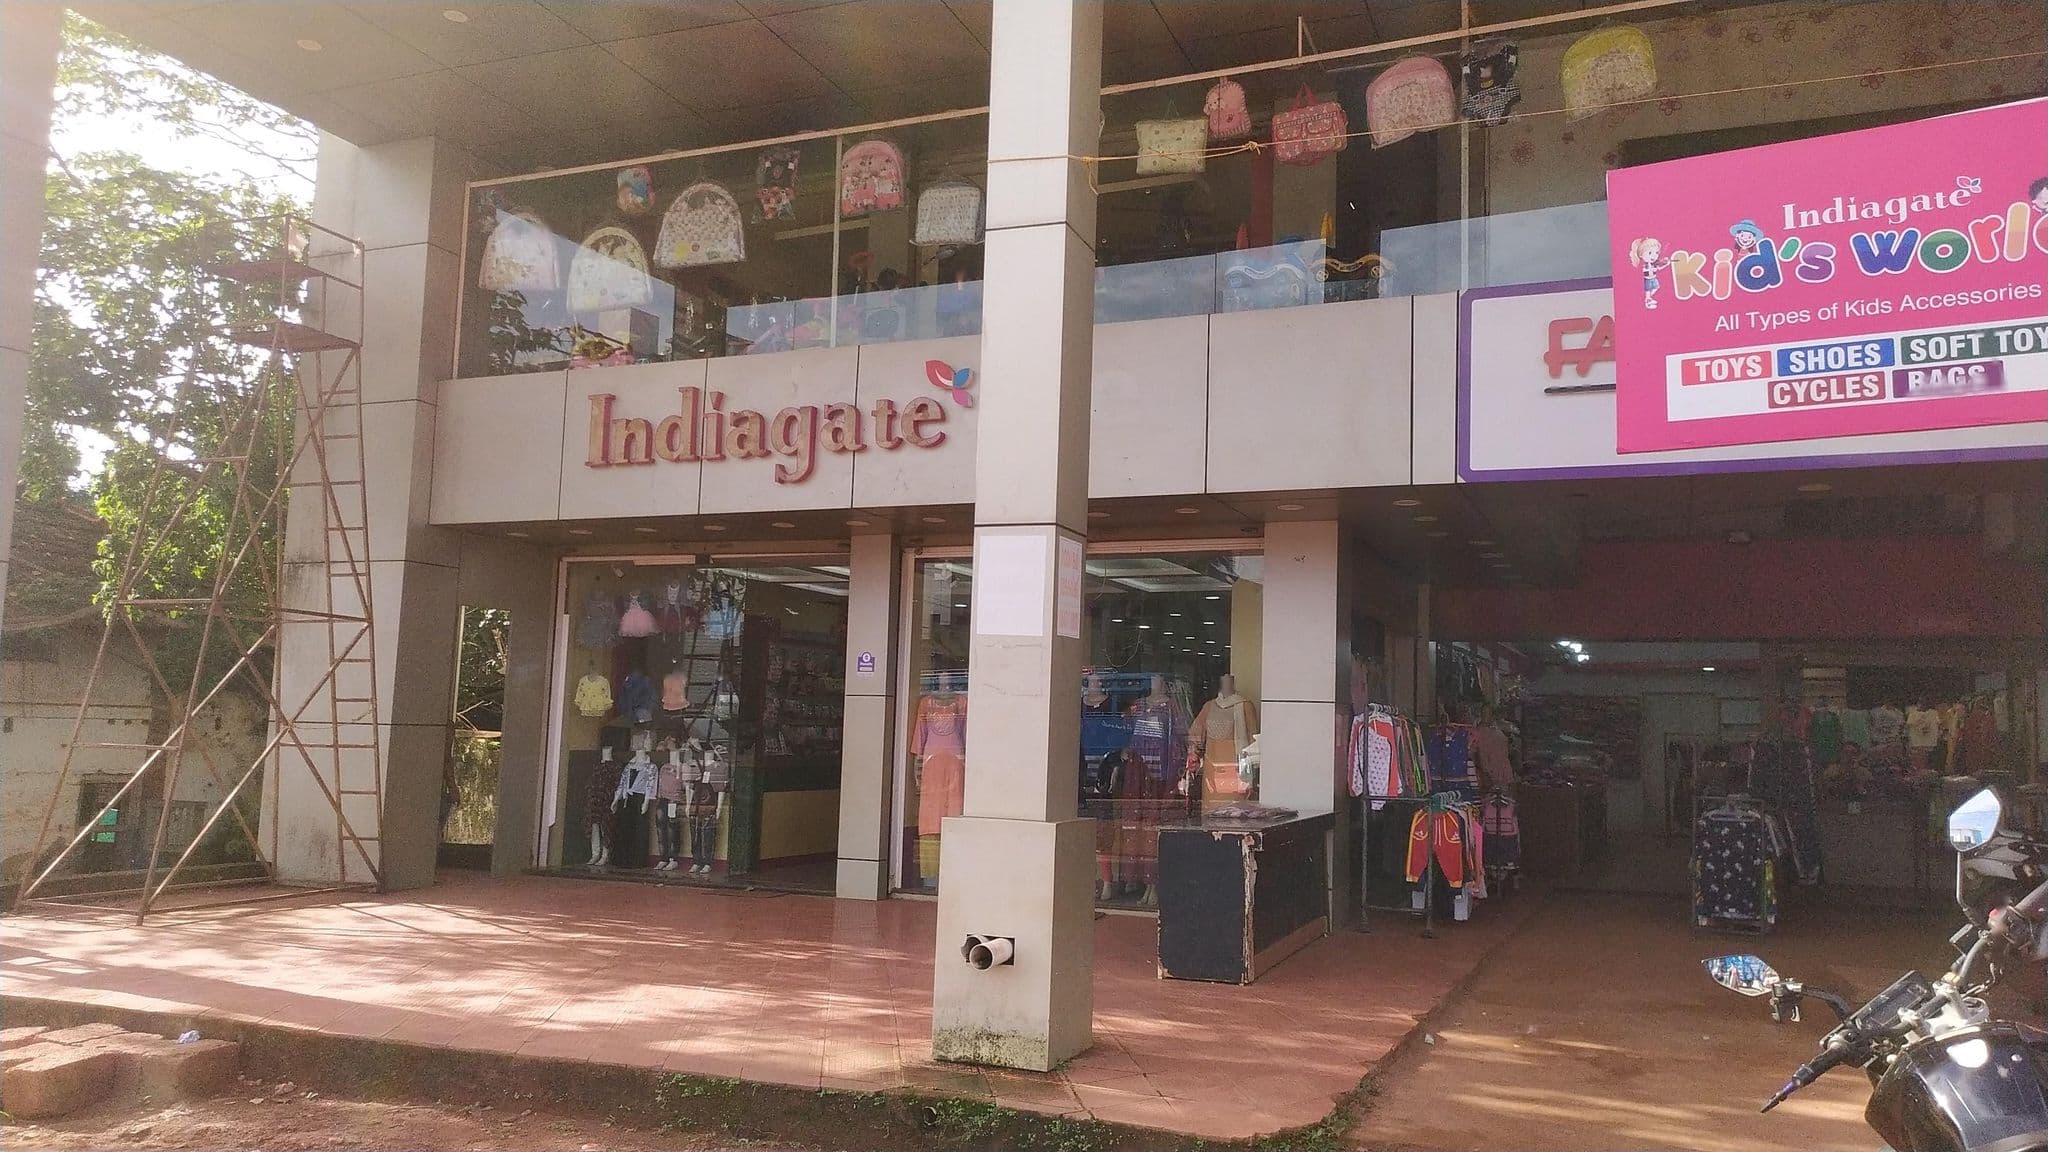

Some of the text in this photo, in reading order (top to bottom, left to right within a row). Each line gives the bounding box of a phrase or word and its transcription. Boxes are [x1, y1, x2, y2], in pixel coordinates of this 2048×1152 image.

[1782, 187, 1971, 231] Indiagate
[1850, 201, 2048, 276] worl
[1715, 283, 2042, 333] All Types of Kids Accessories
[1695, 355, 1762, 381] TOYS
[1790, 343, 1881, 373] SHOES
[1910, 333, 1984, 363] SOFT
[1773, 375, 1881, 406] CYCLES
[586, 386, 947, 484] Indiagate
